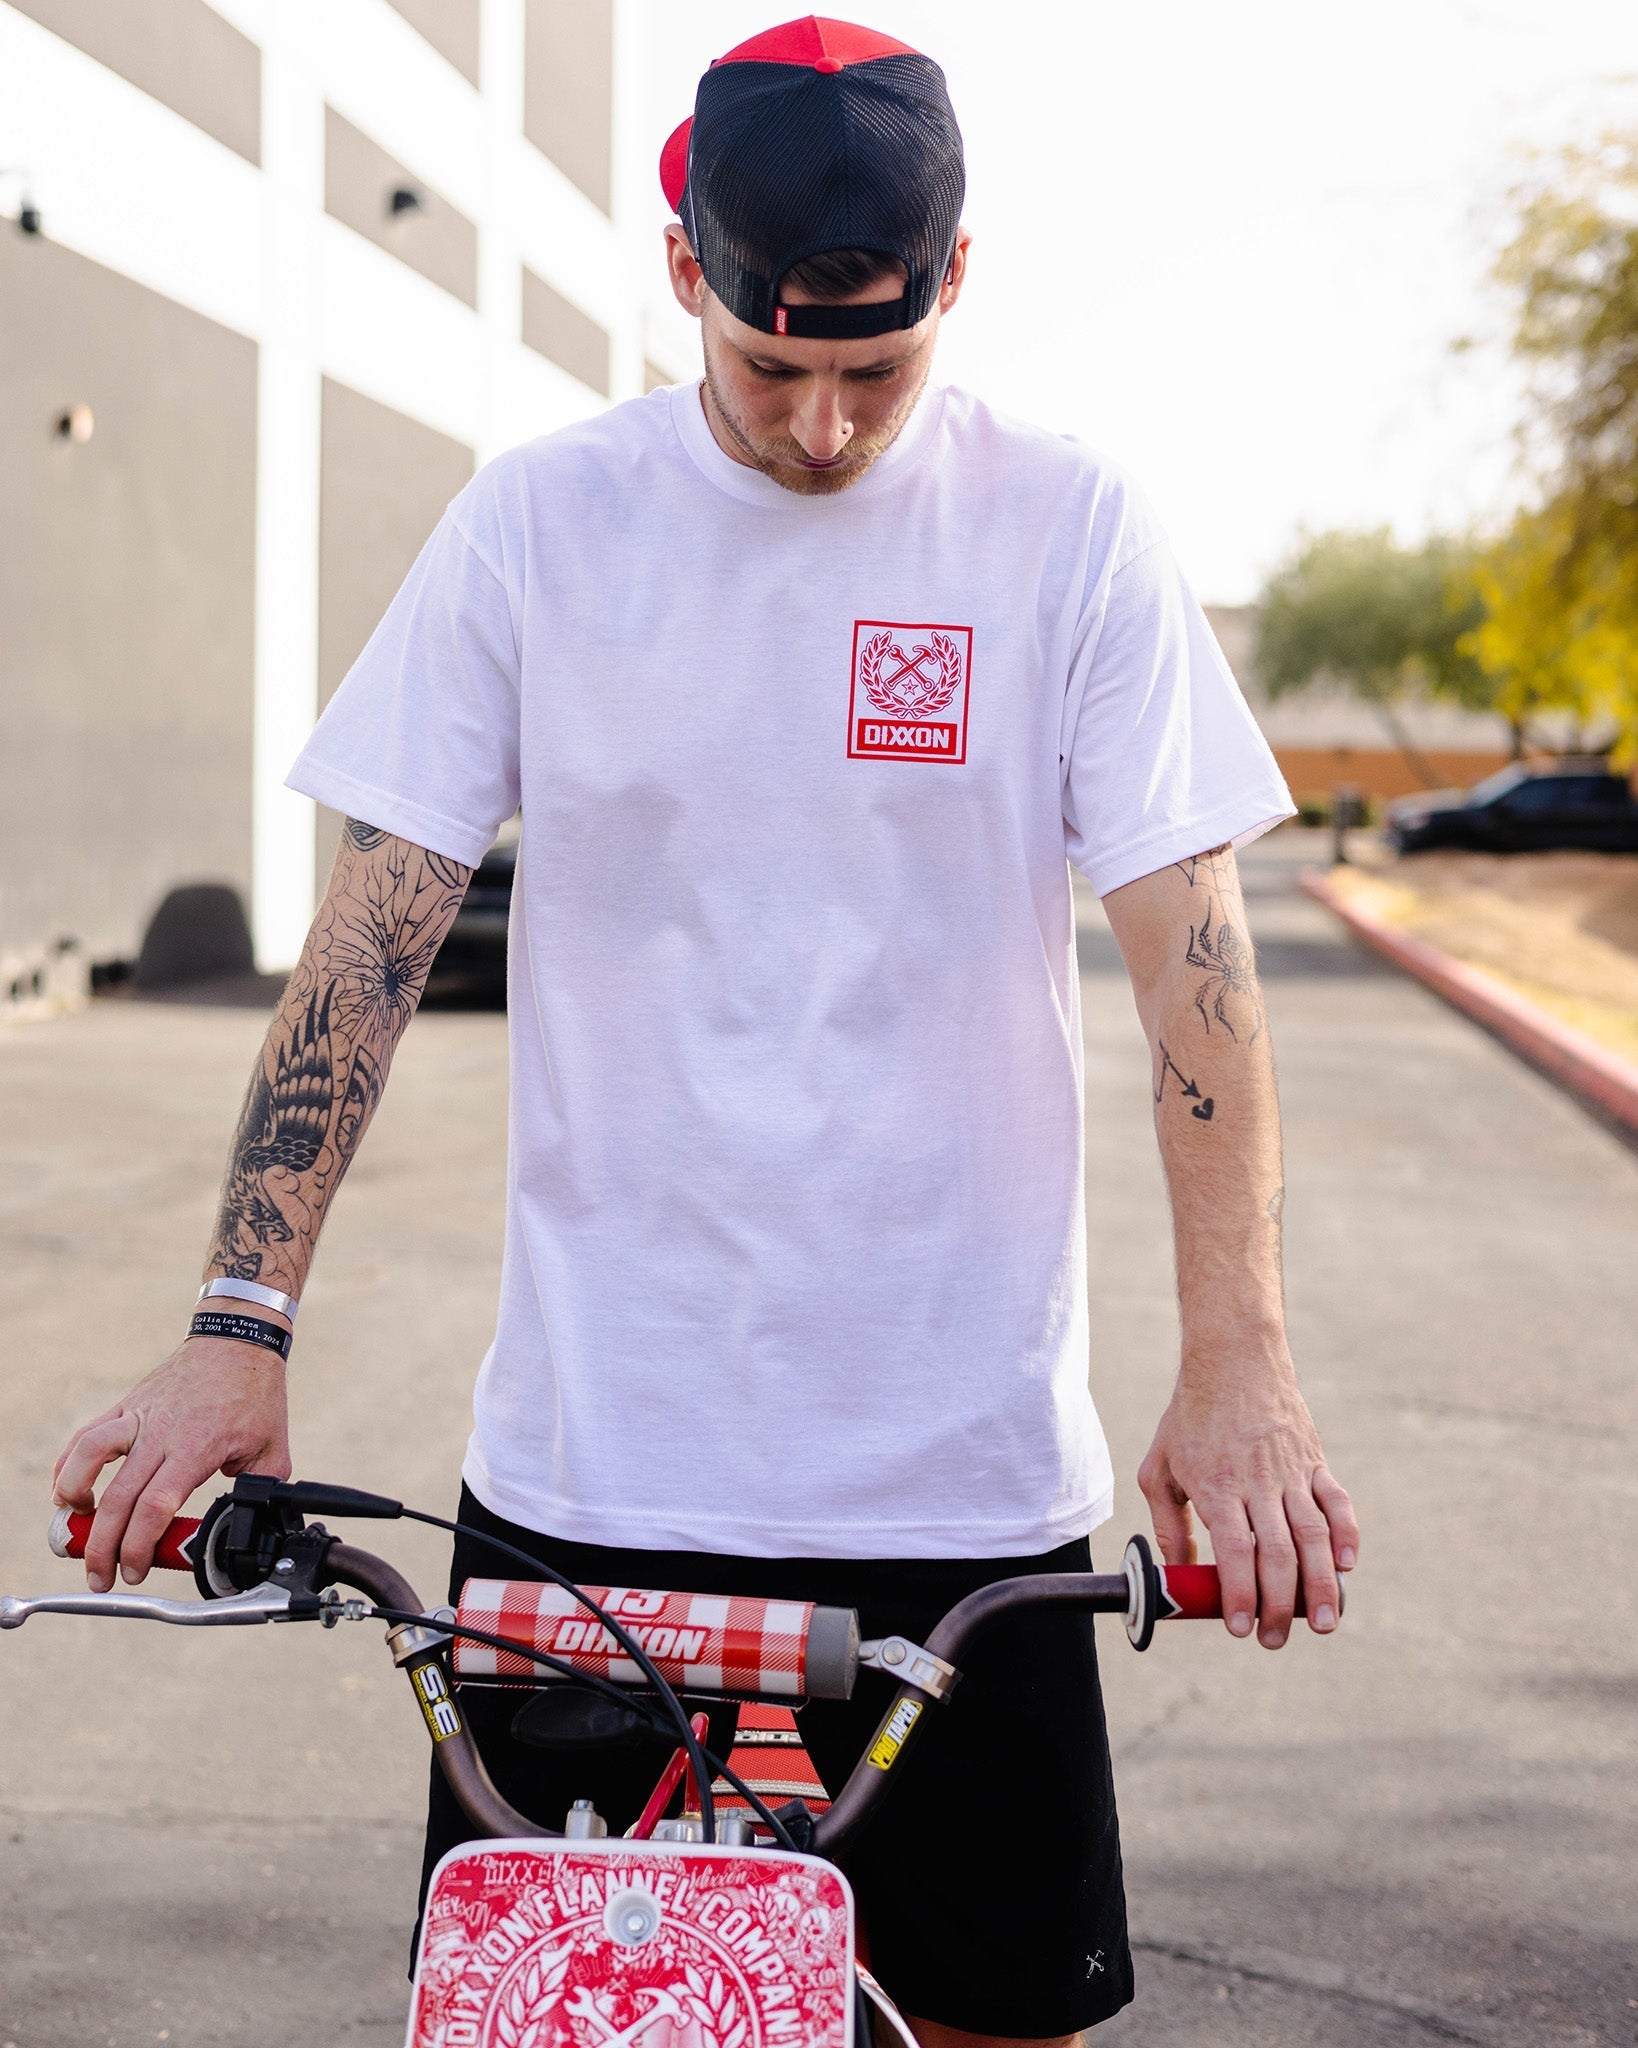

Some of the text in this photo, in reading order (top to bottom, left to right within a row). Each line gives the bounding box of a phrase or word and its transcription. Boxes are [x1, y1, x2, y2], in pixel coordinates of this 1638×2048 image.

[864, 724, 950, 749] DIXXON
[195, 1316, 259, 1329] Collin Lee Teem
[231, 1326, 247, 1336] May
